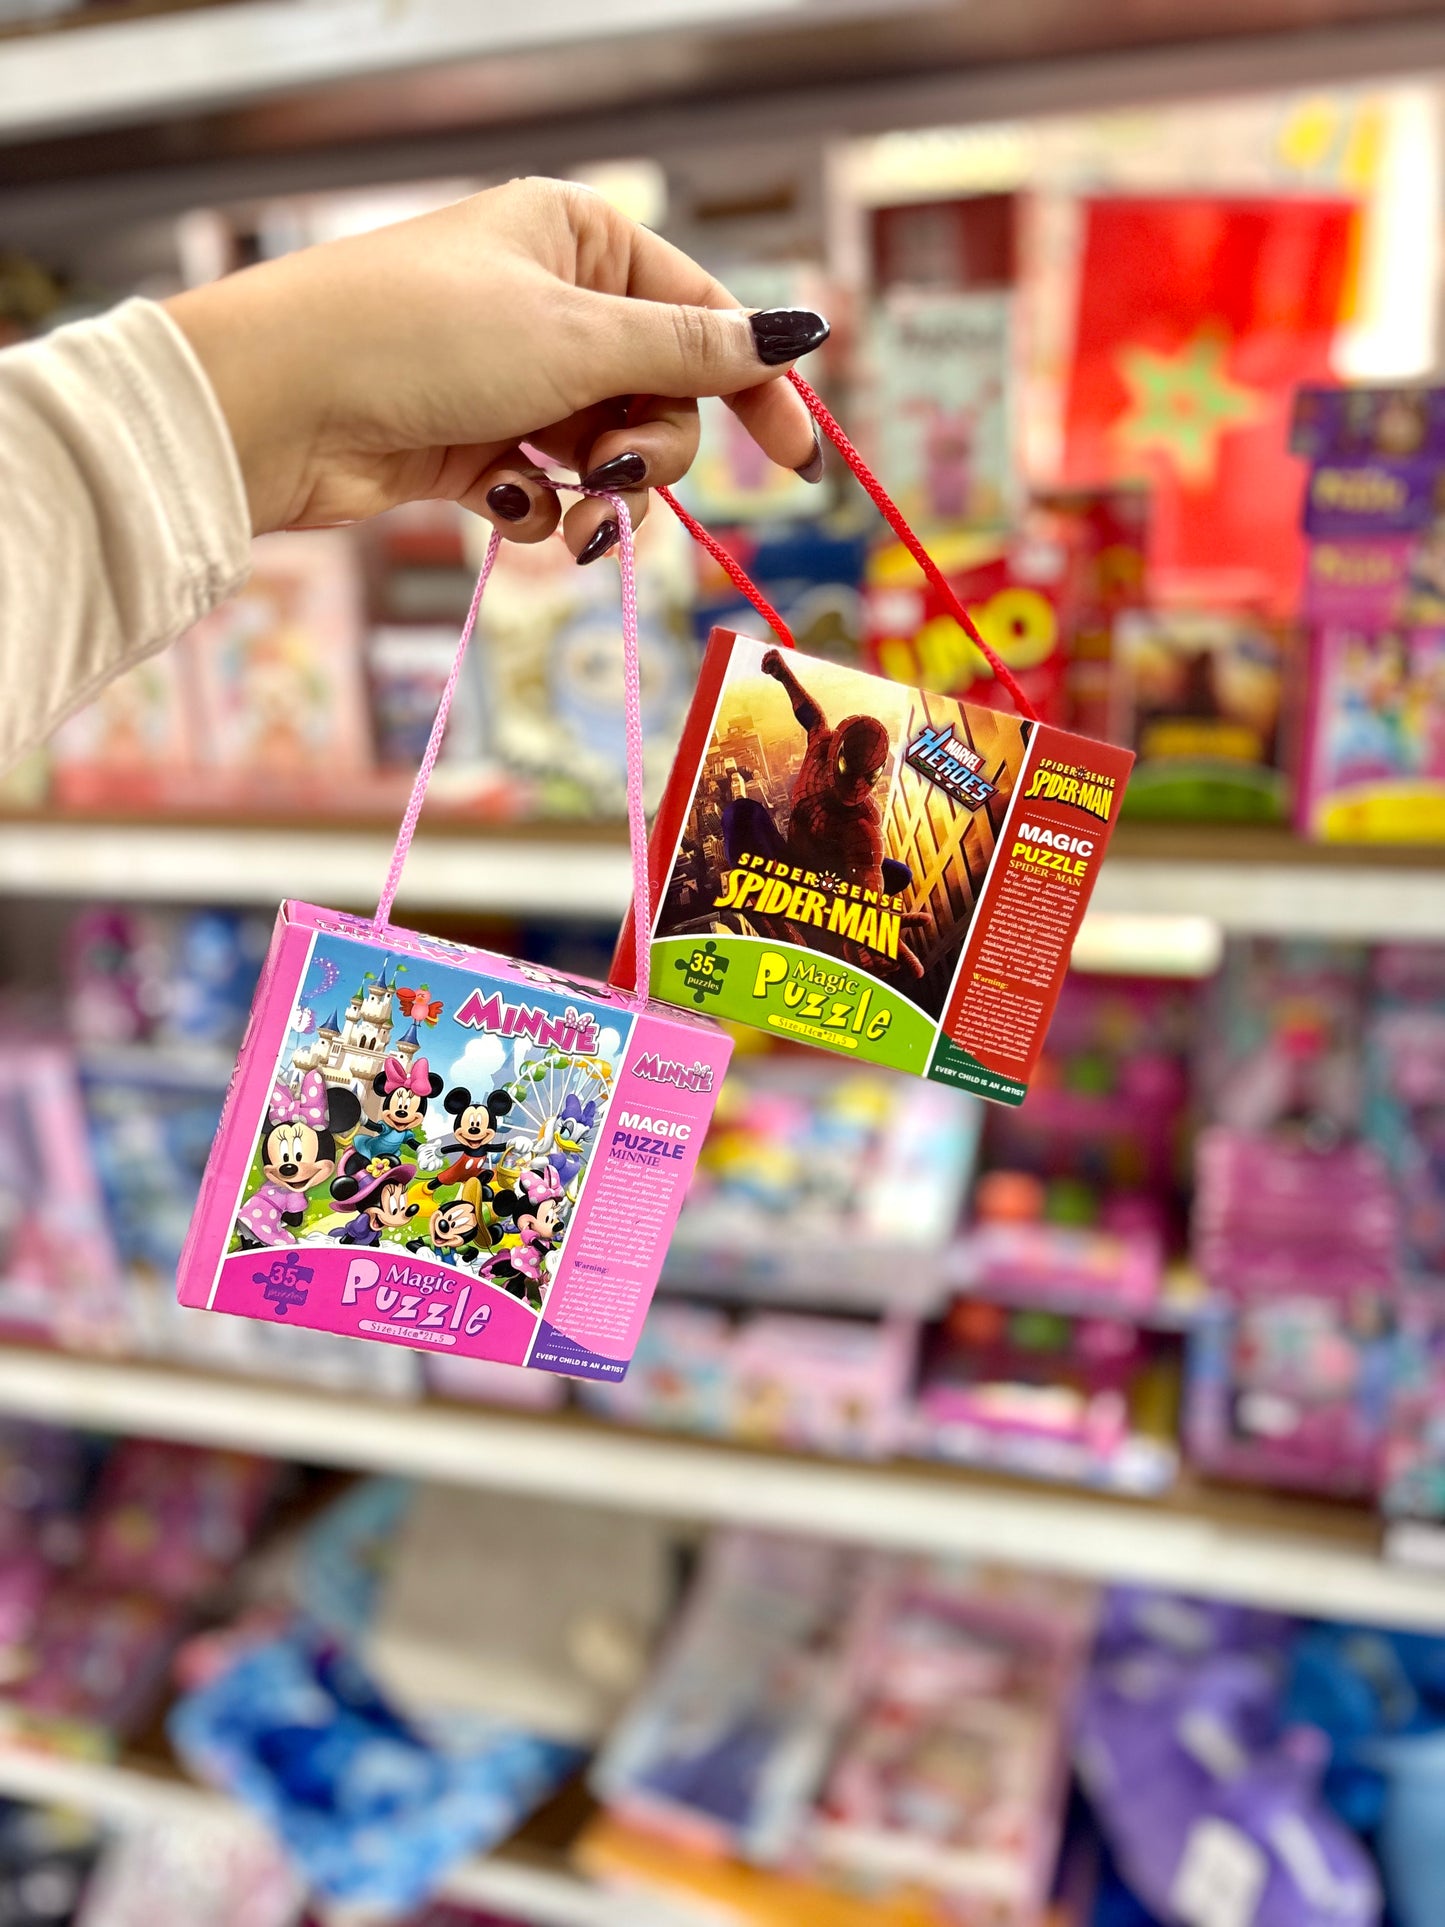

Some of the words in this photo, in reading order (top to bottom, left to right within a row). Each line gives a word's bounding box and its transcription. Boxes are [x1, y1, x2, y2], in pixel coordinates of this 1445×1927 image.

[907, 727, 994, 801] HEROES
[944, 738, 980, 771] MARVEL
[1039, 758, 1077, 777] SPIDER
[1085, 771, 1116, 788] SENSE
[1018, 822, 1094, 857] MAGIC
[1008, 859, 1082, 887] SPIDER-MAN
[1011, 842, 1088, 877] PUZZLE
[738, 853, 818, 887] SPIDER
[838, 881, 903, 911] SENSE
[713, 868, 902, 960] SPIDER-MAN
[690, 952, 716, 976] 35
[793, 960, 859, 994] Magic
[972, 971, 1009, 989] Warning:
[687, 975, 719, 991] puzzles
[753, 951, 892, 1041] Puzzle
[455, 990, 599, 1054] MINNIE
[632, 1052, 714, 1092] MINNIE
[935, 1065, 957, 1077] EVERY
[958, 1072, 980, 1084] CHILD
[988, 1082, 1000, 1090] AN
[1001, 1084, 1025, 1097] ARTIST
[618, 1111, 692, 1140] MAGIC
[608, 1148, 660, 1167] MINNIE
[612, 1131, 686, 1159] PUZZLE
[269, 1265, 299, 1287] 35
[386, 1264, 457, 1295] Magic
[341, 1258, 492, 1336] Puzzle
[535, 1352, 557, 1362] EVERY
[559, 1356, 580, 1366] CHILD
[601, 1364, 624, 1374] ARTIST
